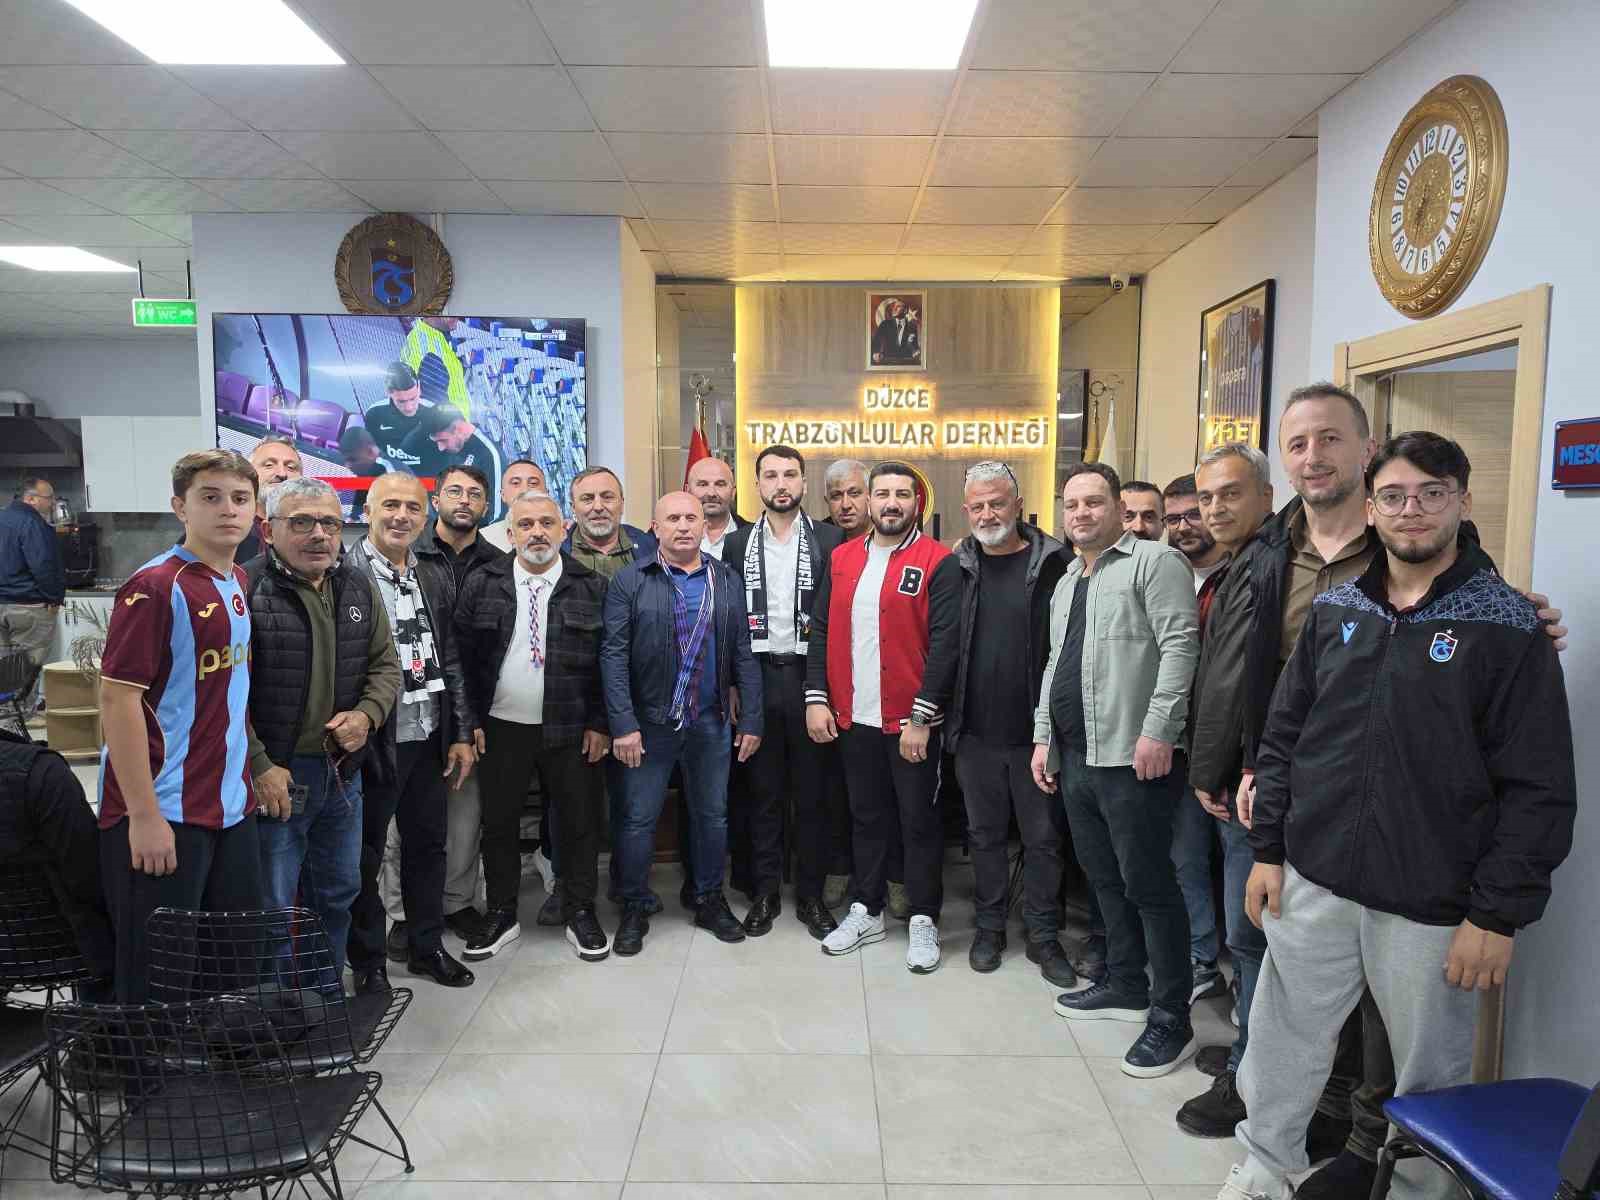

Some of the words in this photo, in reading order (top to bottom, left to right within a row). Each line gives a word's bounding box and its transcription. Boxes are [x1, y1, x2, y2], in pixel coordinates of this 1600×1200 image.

[1423, 130, 1436, 152] 12
[1440, 128, 1451, 151] 1
[1407, 150, 1420, 172] 11
[1451, 143, 1465, 165] 2
[1396, 178, 1408, 197] 10
[1454, 176, 1466, 191] 3
[1391, 212, 1401, 226] 9
[1451, 209, 1461, 224] 4
[1394, 239, 1404, 255] 8
[1437, 239, 1447, 255] 5
[1405, 251, 1415, 271] 7
[1420, 249, 1428, 271] 6
[157, 310, 177, 321] WC
[866, 384, 930, 408] DÜZCE
[747, 422, 934, 445] TRABZONLULAR
[945, 418, 1049, 445] DERNEĞİ
[897, 565, 924, 597] B
[198, 641, 252, 681] pap
